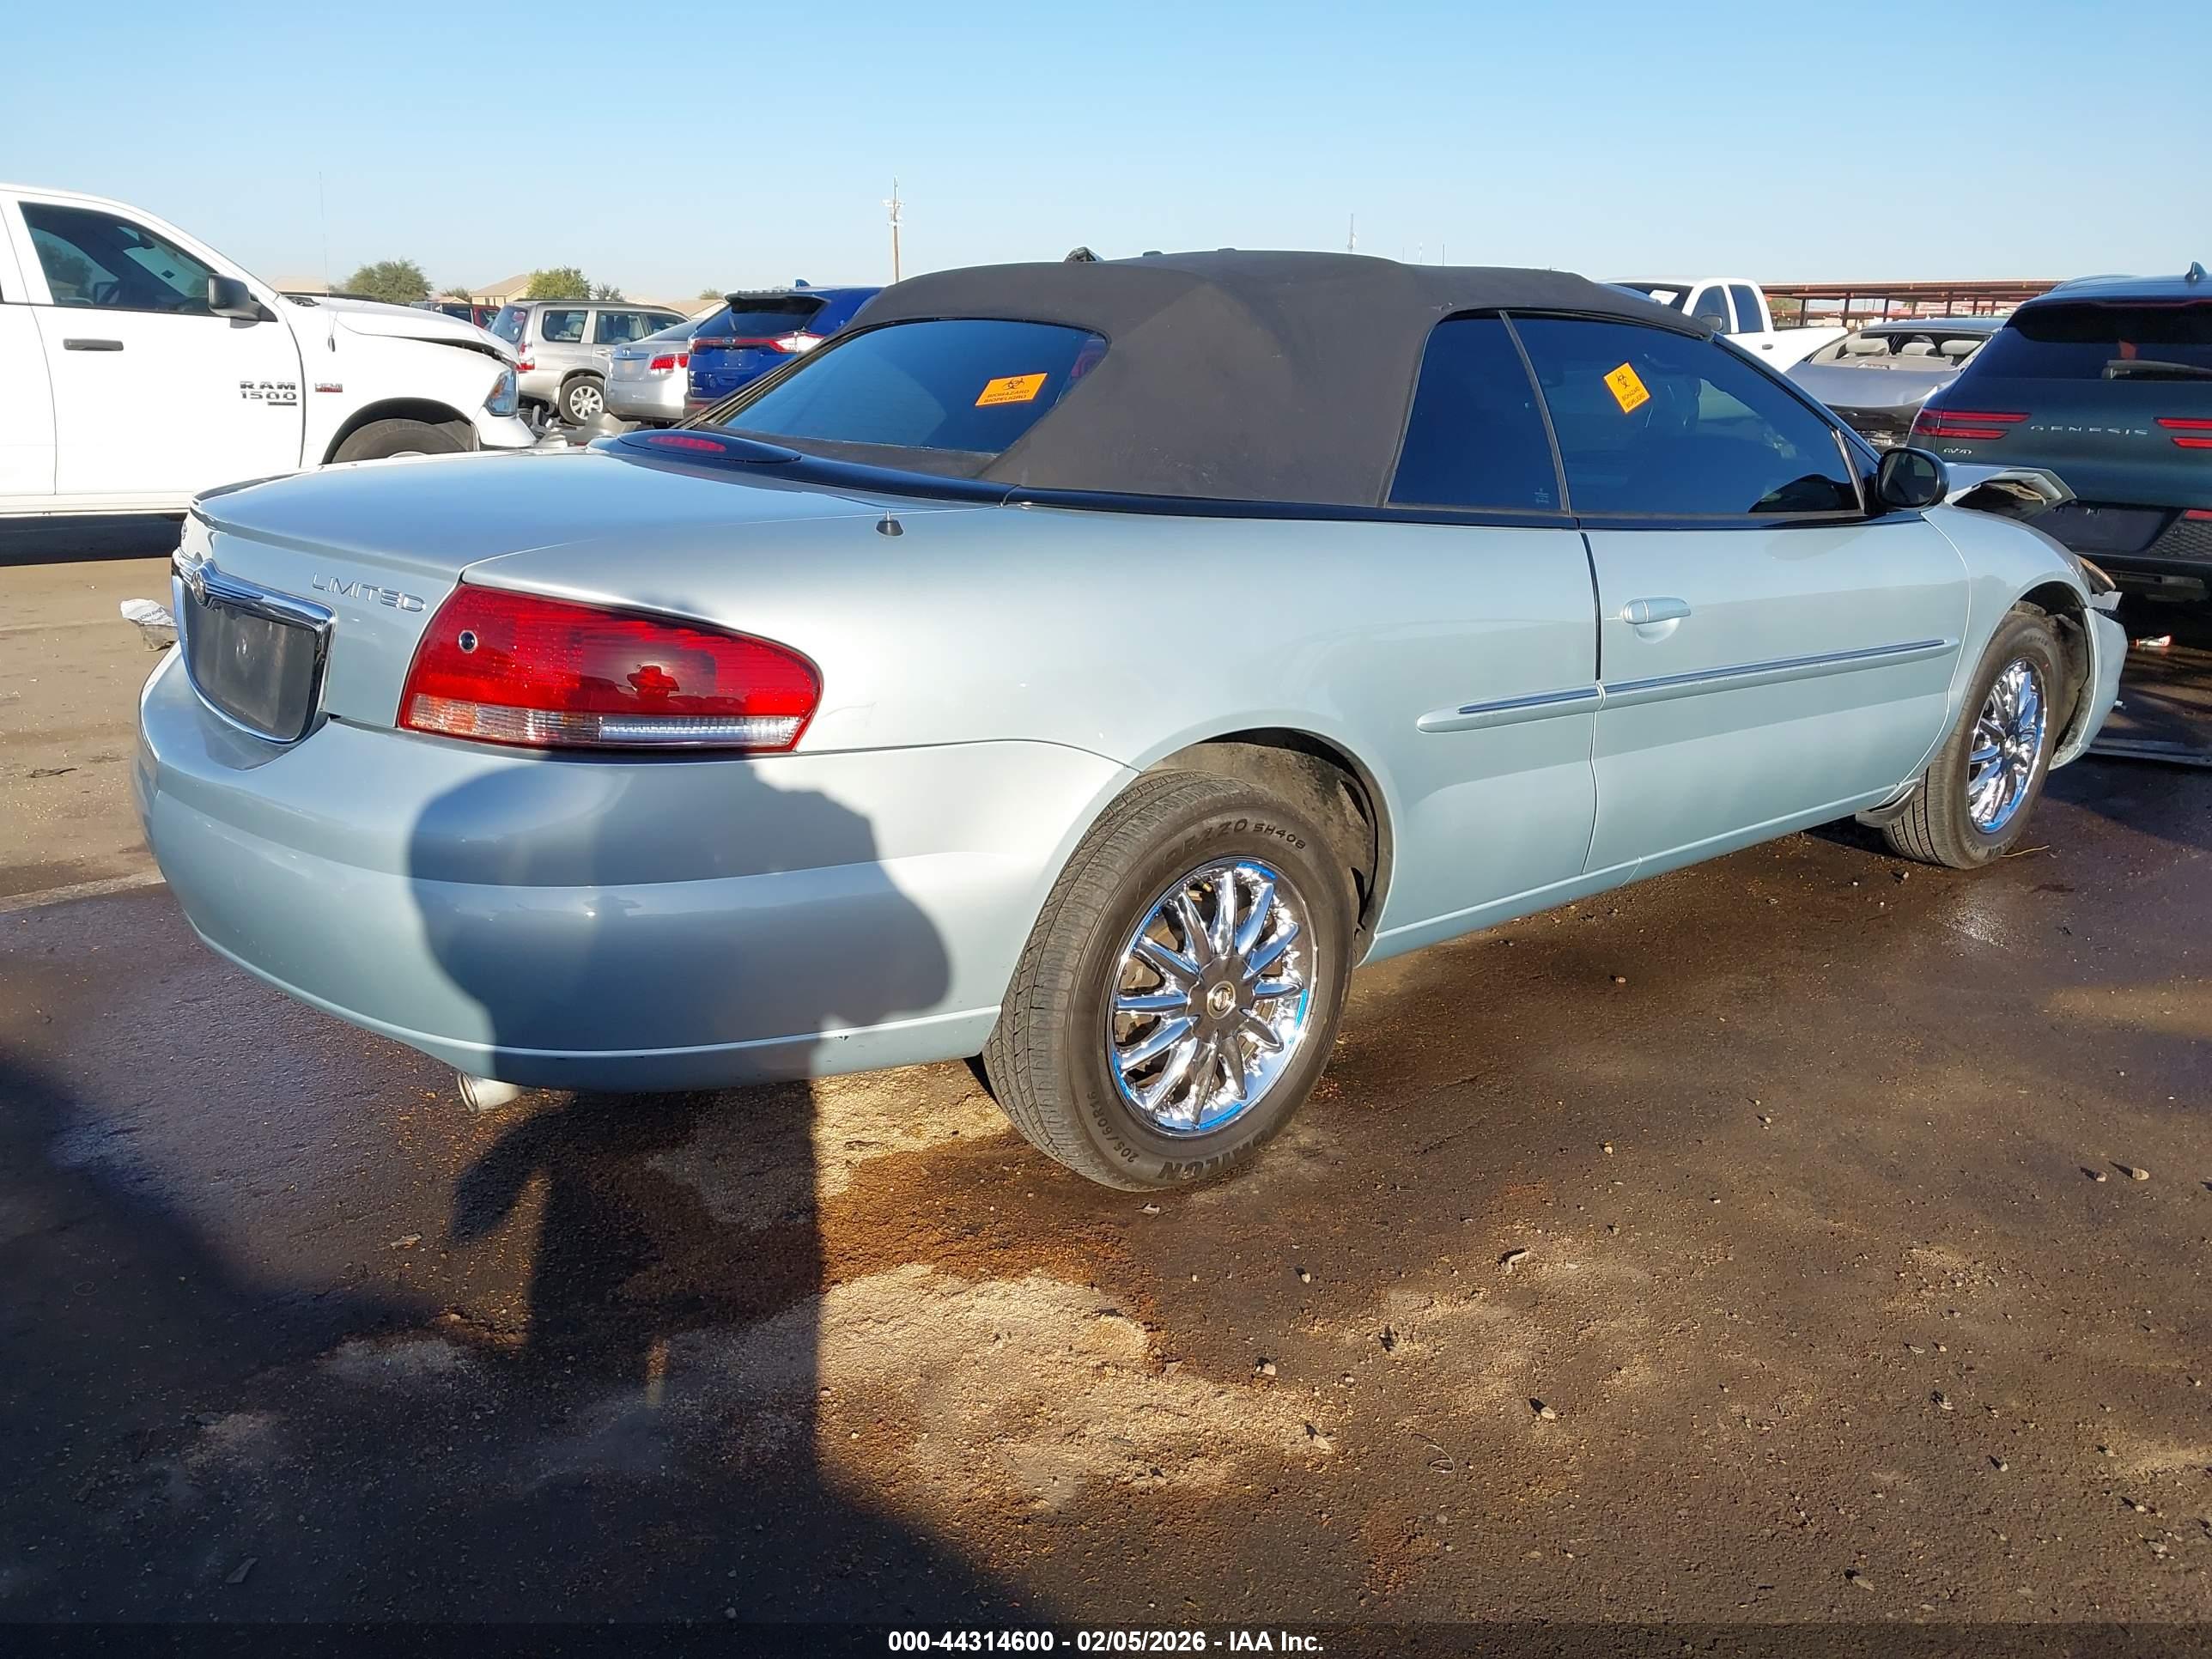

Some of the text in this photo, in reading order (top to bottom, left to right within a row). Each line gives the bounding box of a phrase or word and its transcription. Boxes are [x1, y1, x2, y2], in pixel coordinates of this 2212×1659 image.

[240, 380, 296, 390] RAM
[240, 391, 297, 400] 1500
[2030, 425, 2148, 434] GENESIS
[312, 573, 427, 612] LIMITED
